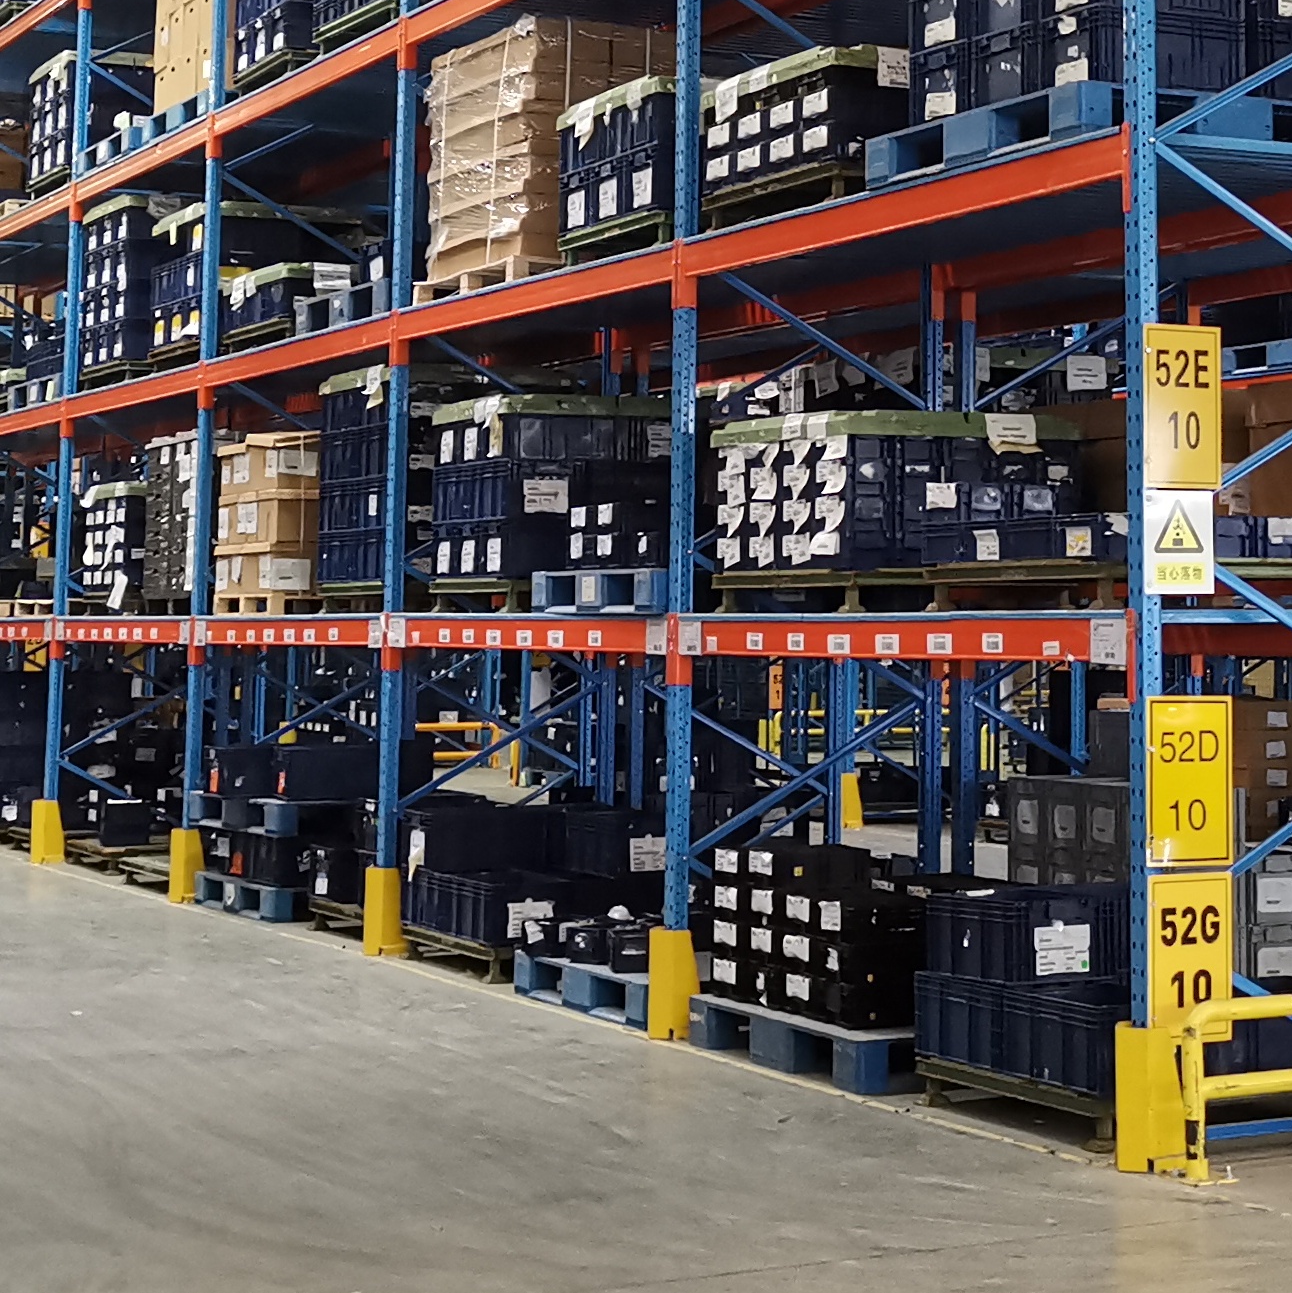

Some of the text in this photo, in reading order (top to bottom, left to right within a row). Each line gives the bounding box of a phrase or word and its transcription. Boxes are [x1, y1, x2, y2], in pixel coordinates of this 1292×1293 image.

[1156, 350, 1209, 388] 52E
[1168, 411, 1200, 449] 10
[1159, 730, 1219, 763] 52D
[1168, 799, 1207, 831] 10
[1160, 904, 1221, 947] 52G
[1171, 968, 1212, 1008] 10
